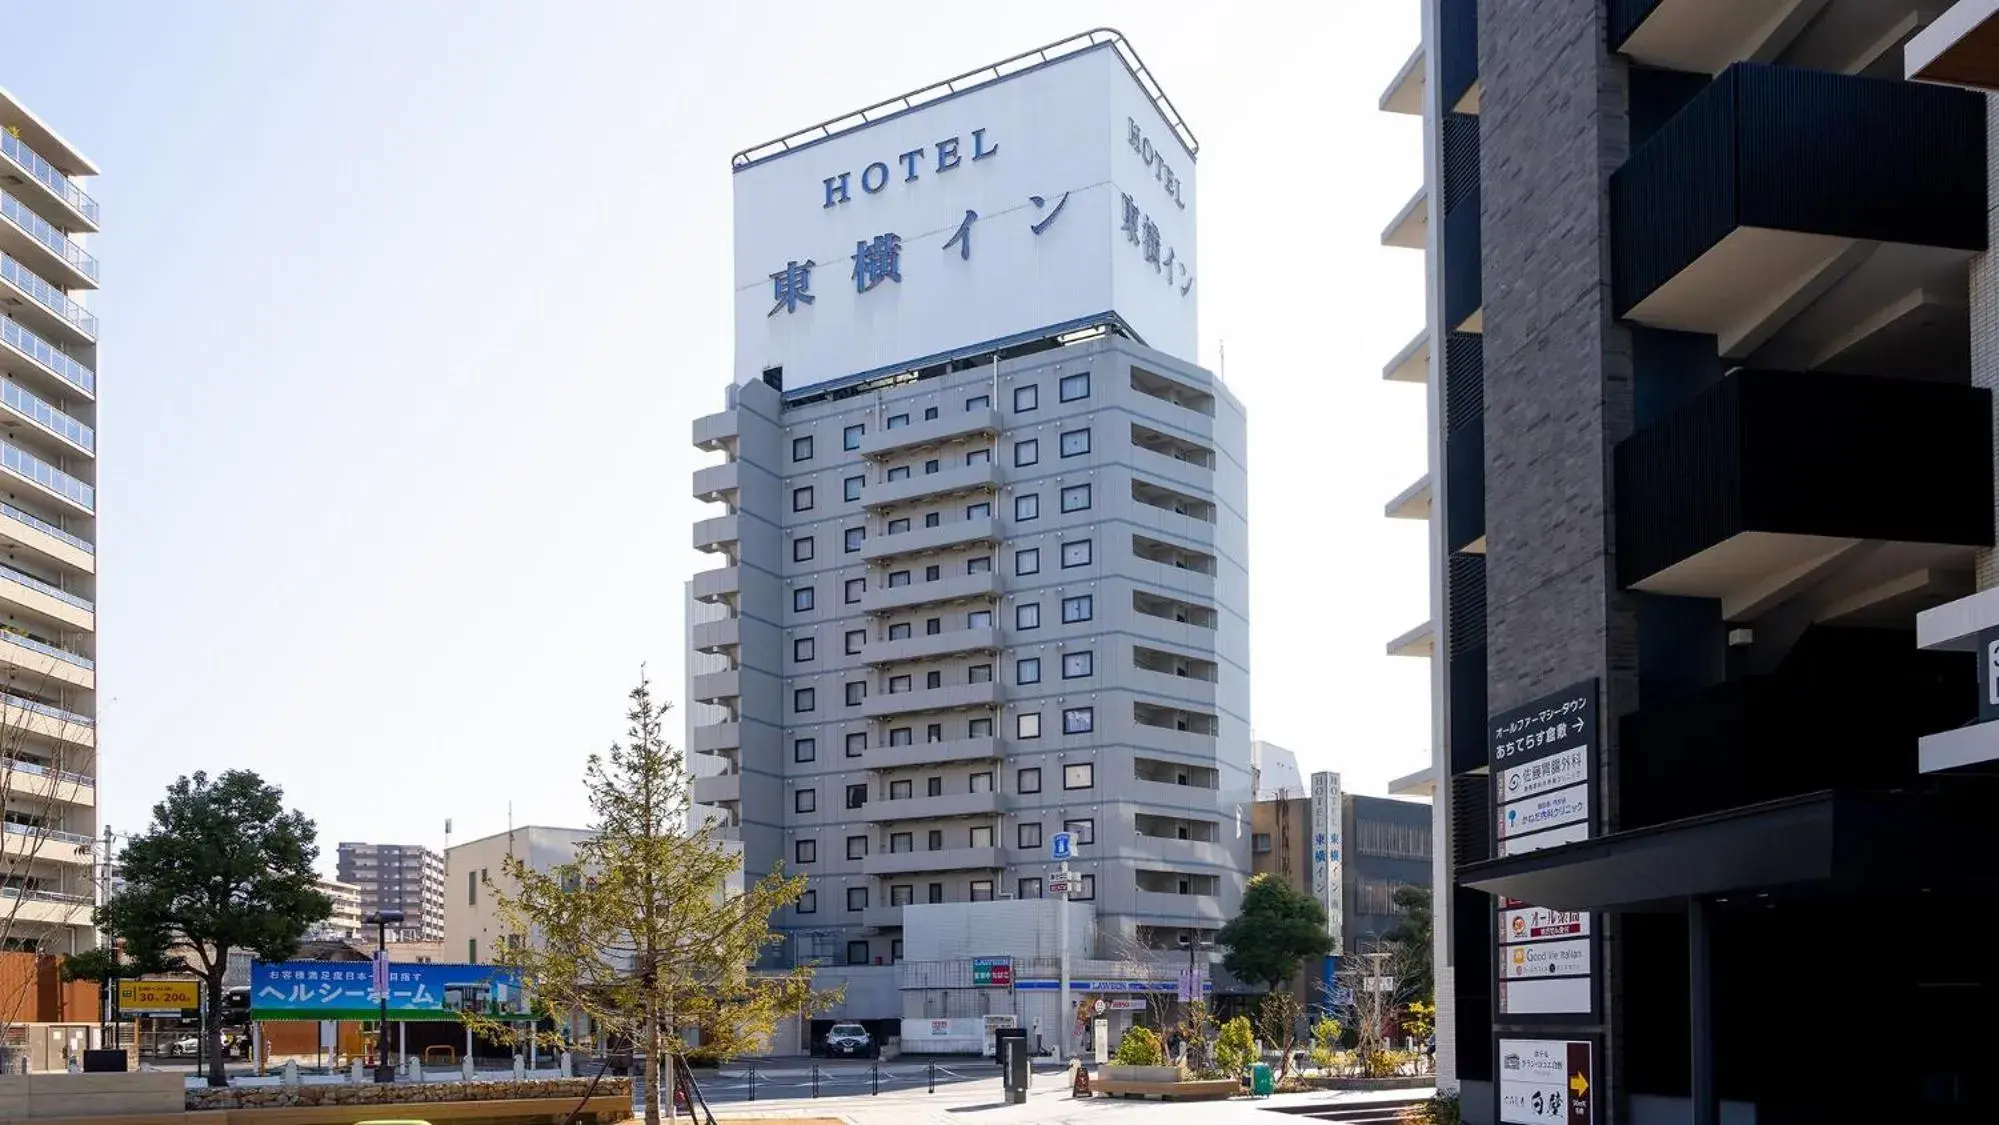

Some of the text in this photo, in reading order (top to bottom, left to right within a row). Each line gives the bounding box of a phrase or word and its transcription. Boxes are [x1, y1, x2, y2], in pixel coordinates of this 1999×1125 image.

[822, 126, 999, 209] HOTEL
[1126, 116, 1186, 210] HOTEL
[766, 190, 1071, 318] 東横イン
[1119, 190, 1195, 297] 東横イン
[1495, 698, 1587, 739] オールファーマシータウン
[1495, 722, 1568, 760] あちてらす倉敷
[1314, 833, 1326, 893] 東横イン
[258, 982, 435, 1004] ヘルシーホーム
[269, 970, 422, 982] お客様満足度日本一目指す
[1091, 981, 1127, 990] LAWSON
